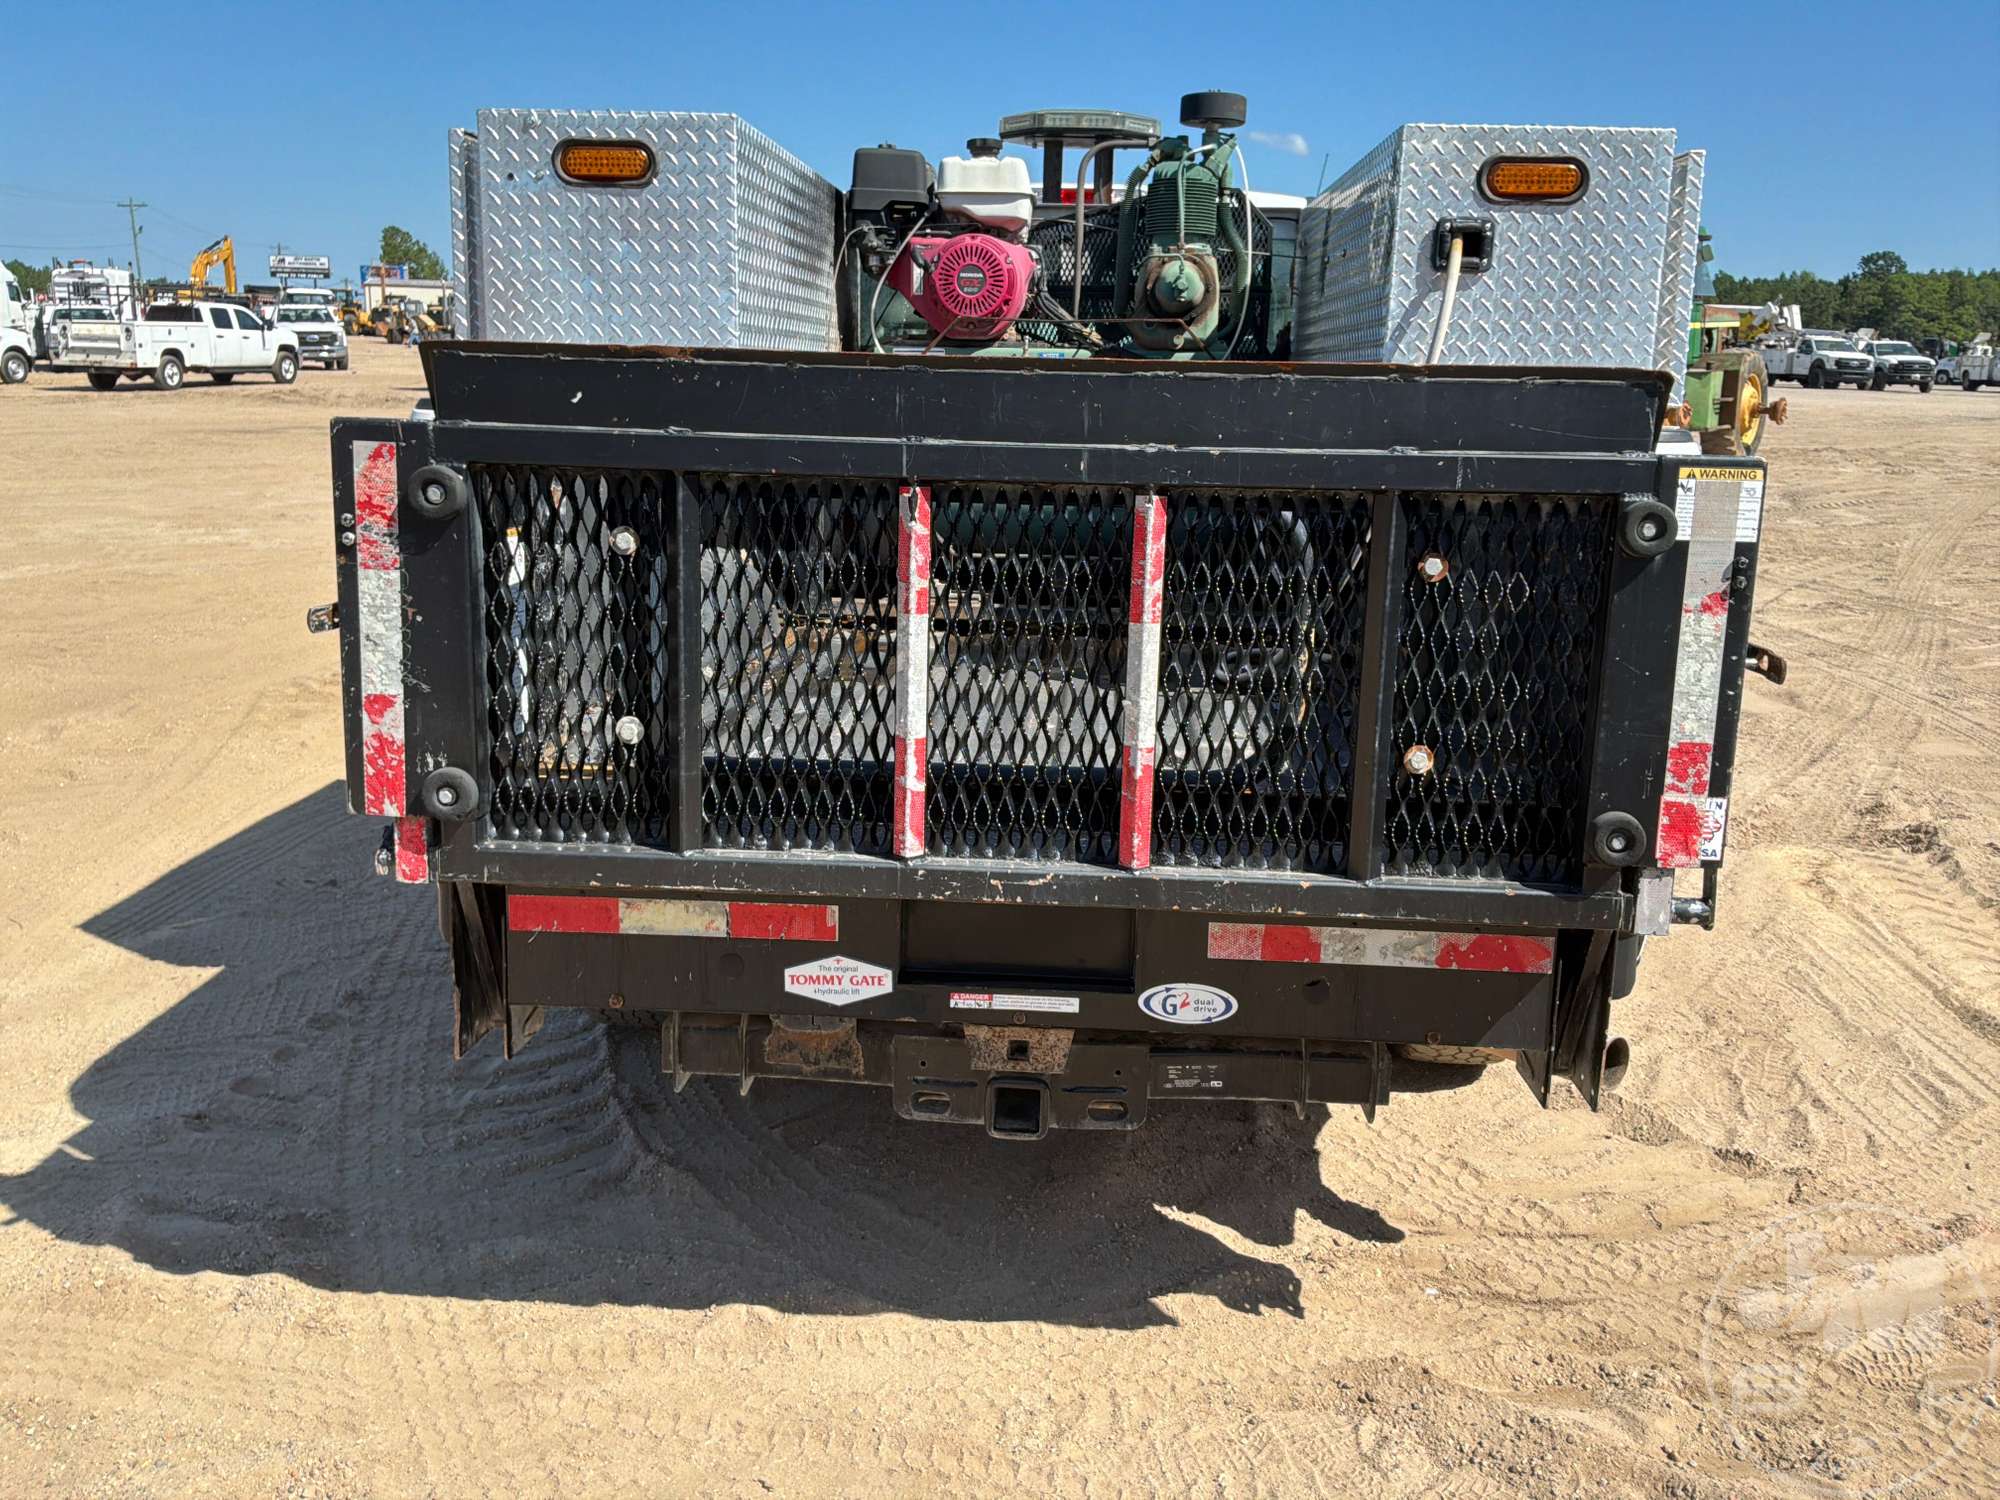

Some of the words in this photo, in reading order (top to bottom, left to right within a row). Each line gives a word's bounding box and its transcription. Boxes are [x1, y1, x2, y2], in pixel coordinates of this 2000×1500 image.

[1699, 469, 1758, 480] WARNING
[1701, 848, 1718, 858] SA
[833, 965, 859, 973] original
[788, 974, 844, 985] TOMMY
[849, 975, 885, 986] GATE
[817, 987, 850, 996] hydraulic
[850, 987, 860, 995] lift
[960, 993, 989, 1001] DANGER
